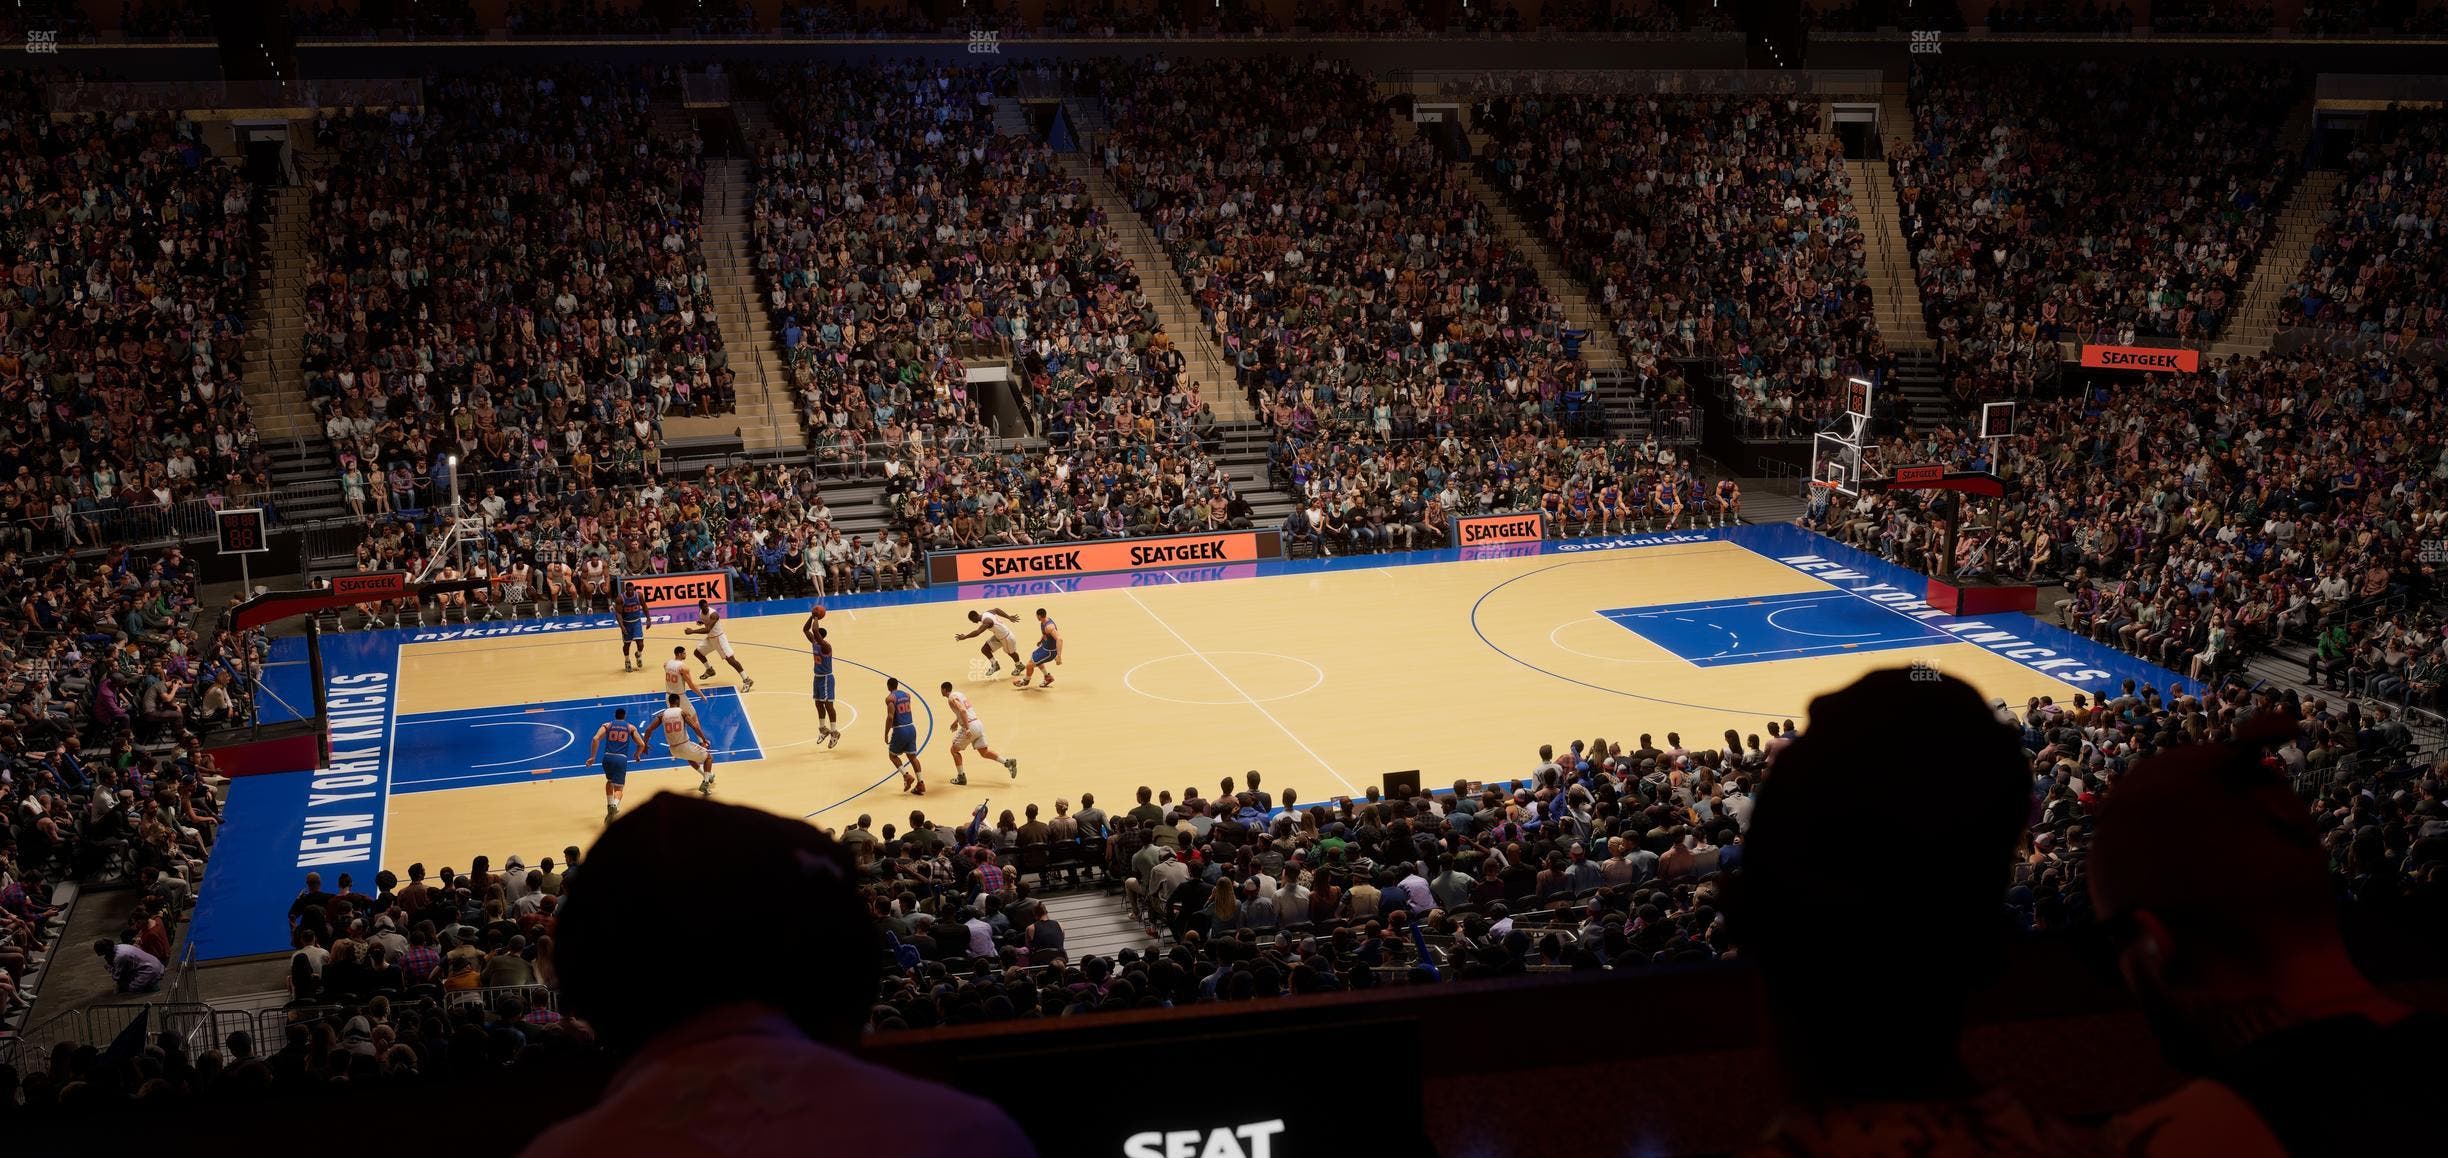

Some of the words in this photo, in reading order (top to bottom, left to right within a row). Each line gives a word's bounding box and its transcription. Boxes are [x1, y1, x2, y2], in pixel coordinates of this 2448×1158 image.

[2101, 351, 2178, 368] SEATGEEK
[1902, 469, 1937, 480] SEATGEEK
[1465, 520, 1537, 541] SEATGEEK
[1558, 534, 1709, 551] @nyknicks
[982, 550, 1083, 577] SEATGEEK
[1130, 540, 1227, 565] SEATGEEK
[340, 577, 396, 591] SEATGEEK
[413, 615, 671, 641] nyknicks.cm
[1777, 554, 1870, 580] NEW
[1850, 583, 1952, 620] YORK
[1940, 621, 2111, 682] KNICKS
[326, 672, 389, 742] KNICKS
[608, 730, 629, 742] 00
[308, 746, 381, 807] YORK
[297, 813, 374, 867] NEW
